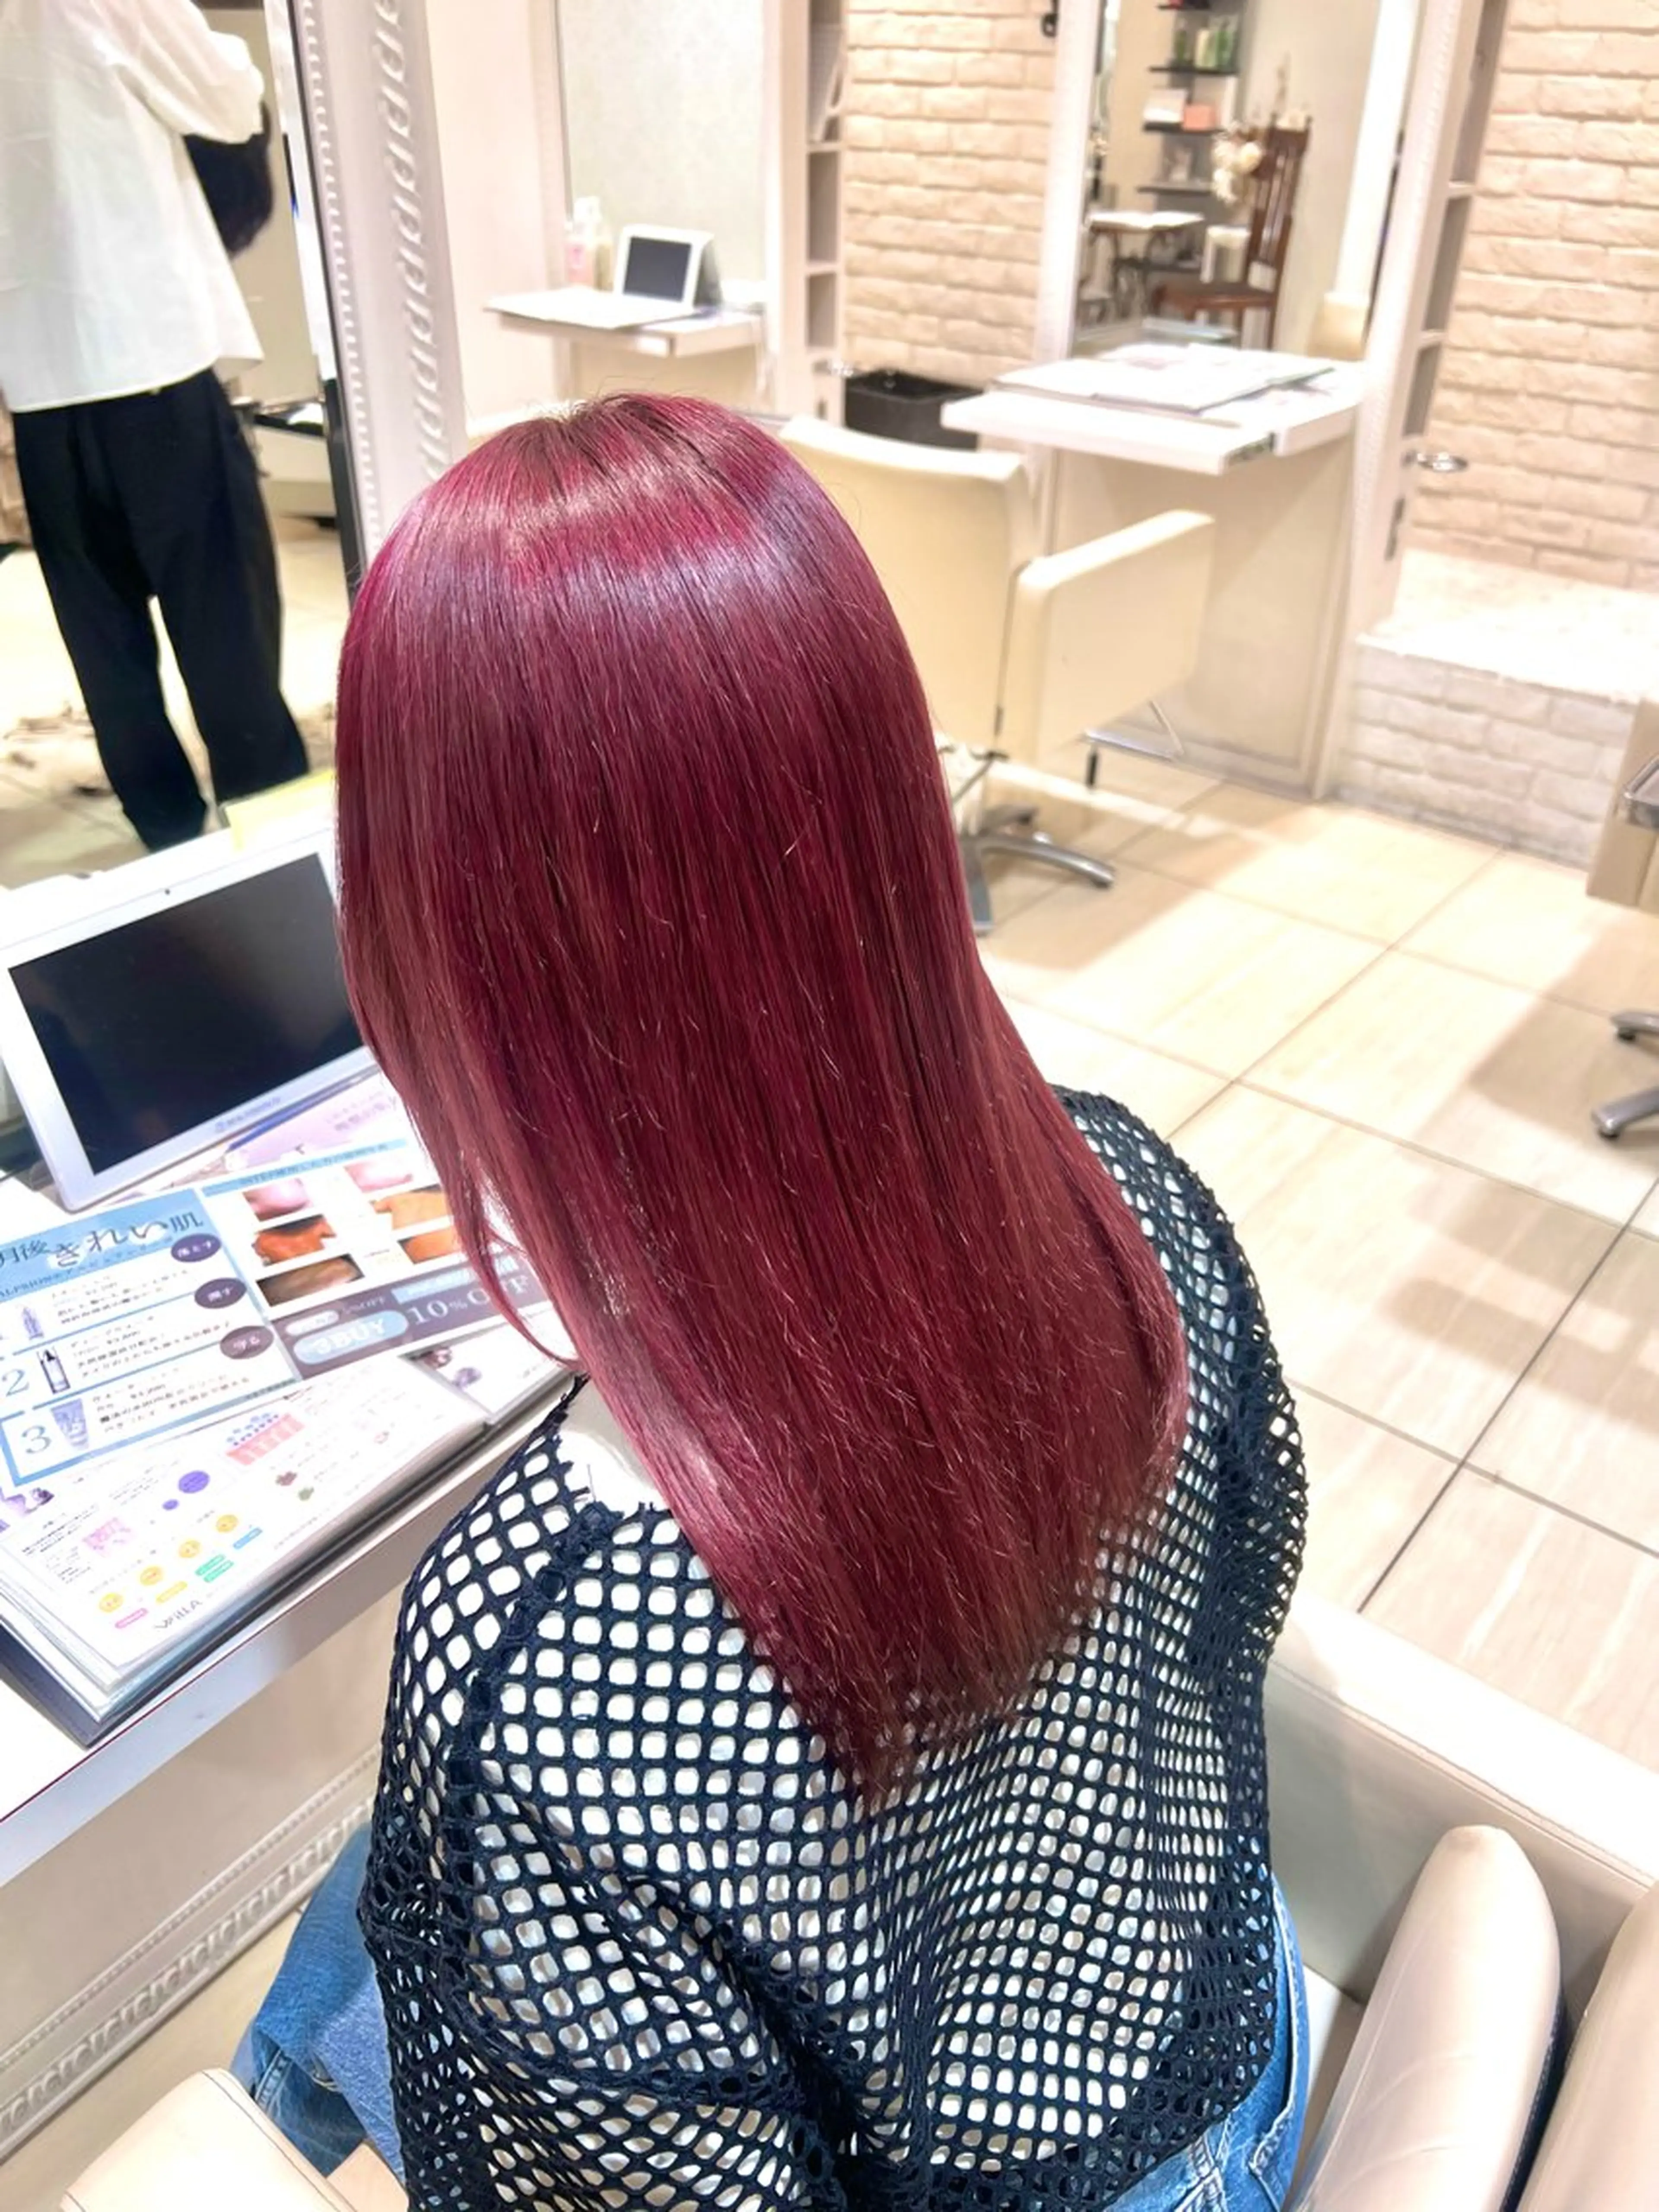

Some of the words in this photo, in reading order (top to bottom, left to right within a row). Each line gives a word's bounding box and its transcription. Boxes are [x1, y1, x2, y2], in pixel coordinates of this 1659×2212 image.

[311, 1317, 386, 1356] 3BUY
[1, 1369, 30, 1396] 2
[21, 1425, 51, 1454] 3
